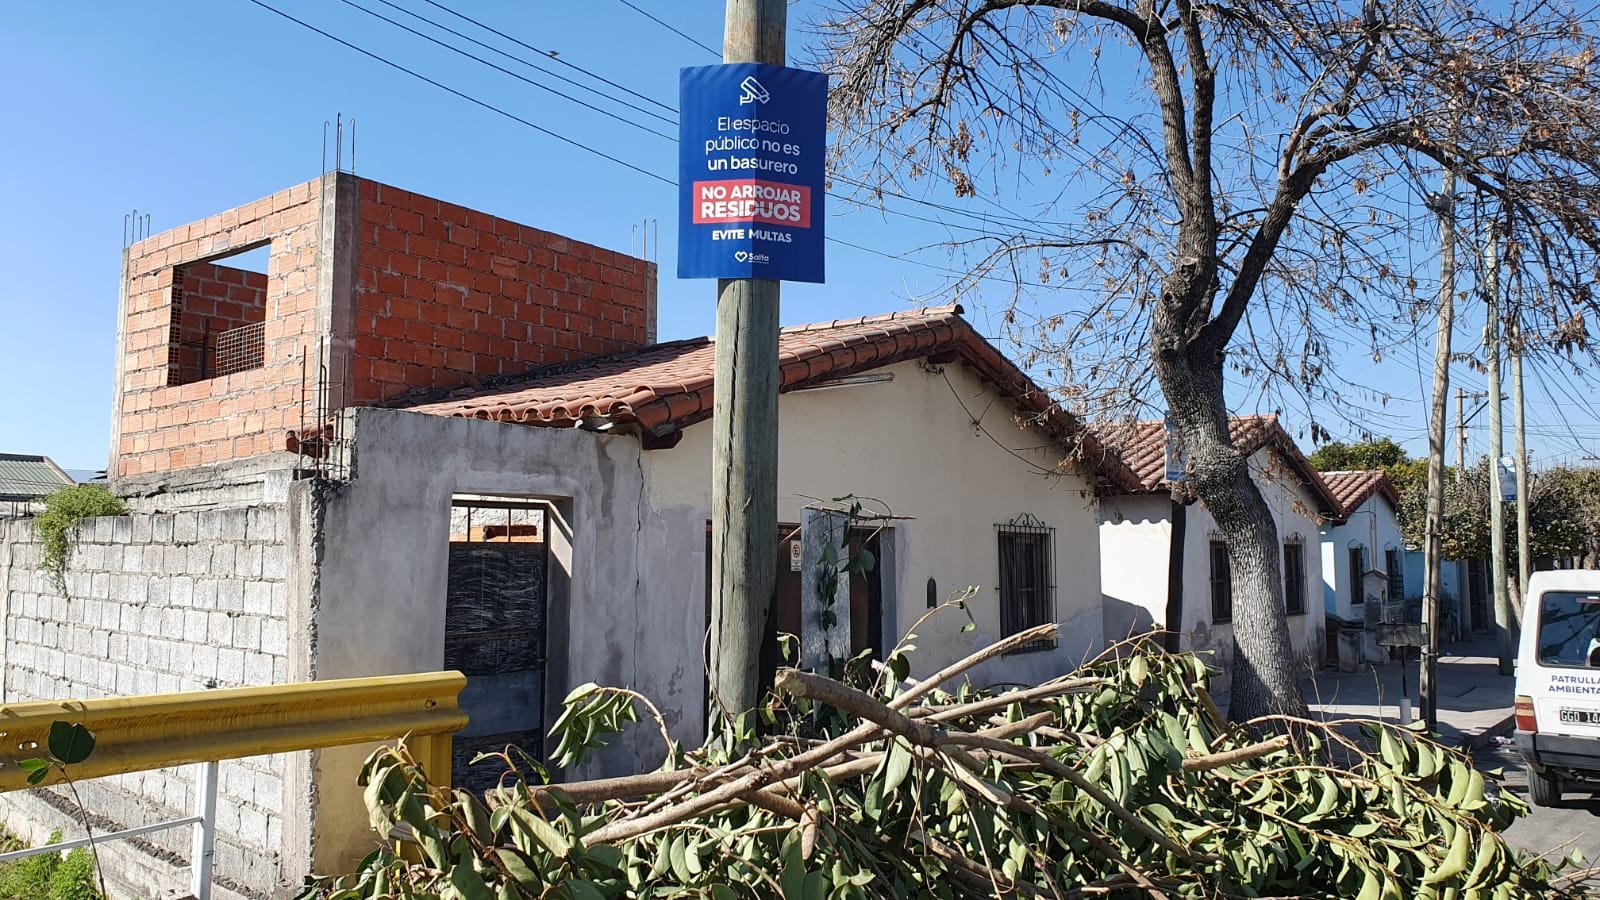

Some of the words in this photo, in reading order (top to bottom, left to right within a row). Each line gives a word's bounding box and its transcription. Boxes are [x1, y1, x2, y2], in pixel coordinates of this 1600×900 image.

[718, 117, 730, 131] El
[733, 118, 790, 135] espacio
[705, 135, 759, 155] público
[762, 140, 780, 152] no
[783, 144, 800, 156] es
[708, 159, 728, 171] un
[730, 155, 798, 175] basurero
[702, 186, 726, 200] NO
[730, 185, 801, 204] ARROJAR
[701, 200, 801, 222] RESIDUOS
[712, 229, 745, 241] EVITE
[749, 229, 792, 243] MULTAS
[748, 253, 769, 262] Salta
[1585, 711, 1600, 723] 14
